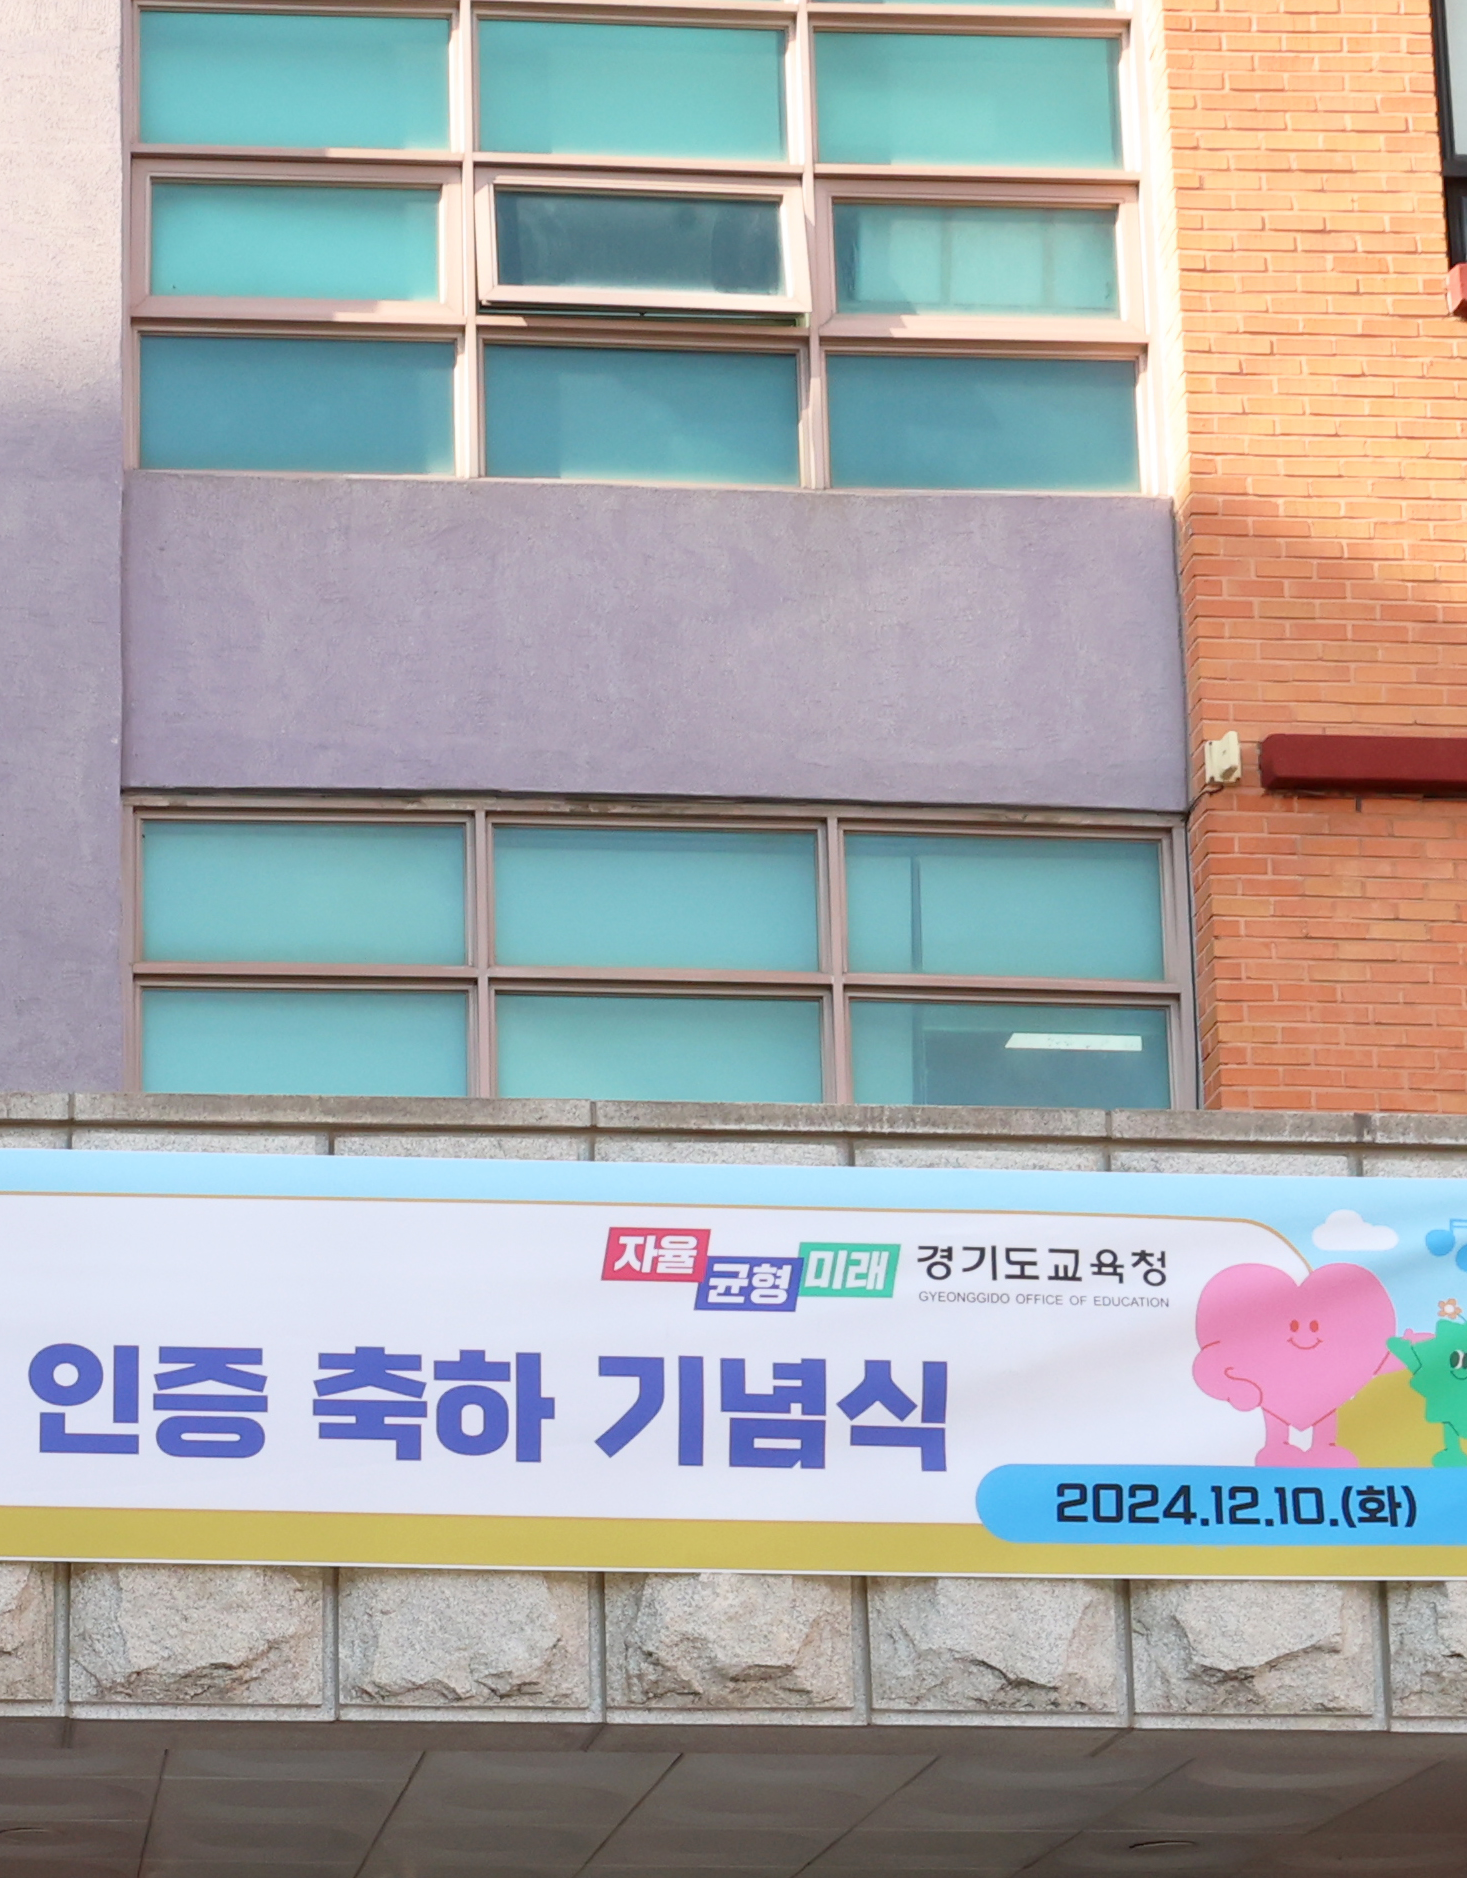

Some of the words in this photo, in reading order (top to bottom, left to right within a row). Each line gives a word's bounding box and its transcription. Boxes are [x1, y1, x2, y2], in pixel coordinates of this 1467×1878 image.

[612, 1234, 698, 1275] 자율
[707, 1262, 793, 1305] 균형
[804, 1250, 890, 1291] 미래
[917, 1245, 1167, 1287] 경기도교육청
[918, 1290, 1011, 1305] GYEONGGIDO
[1015, 1293, 1063, 1306] OFFICE
[1069, 1294, 1087, 1306] OF
[1093, 1295, 1170, 1308] EDUCATION
[27, 1342, 269, 1459] 인증
[312, 1345, 556, 1463] 축하
[594, 1354, 948, 1472] 기념식
[1056, 1482, 1417, 1528] 2024.12.10.(화)
